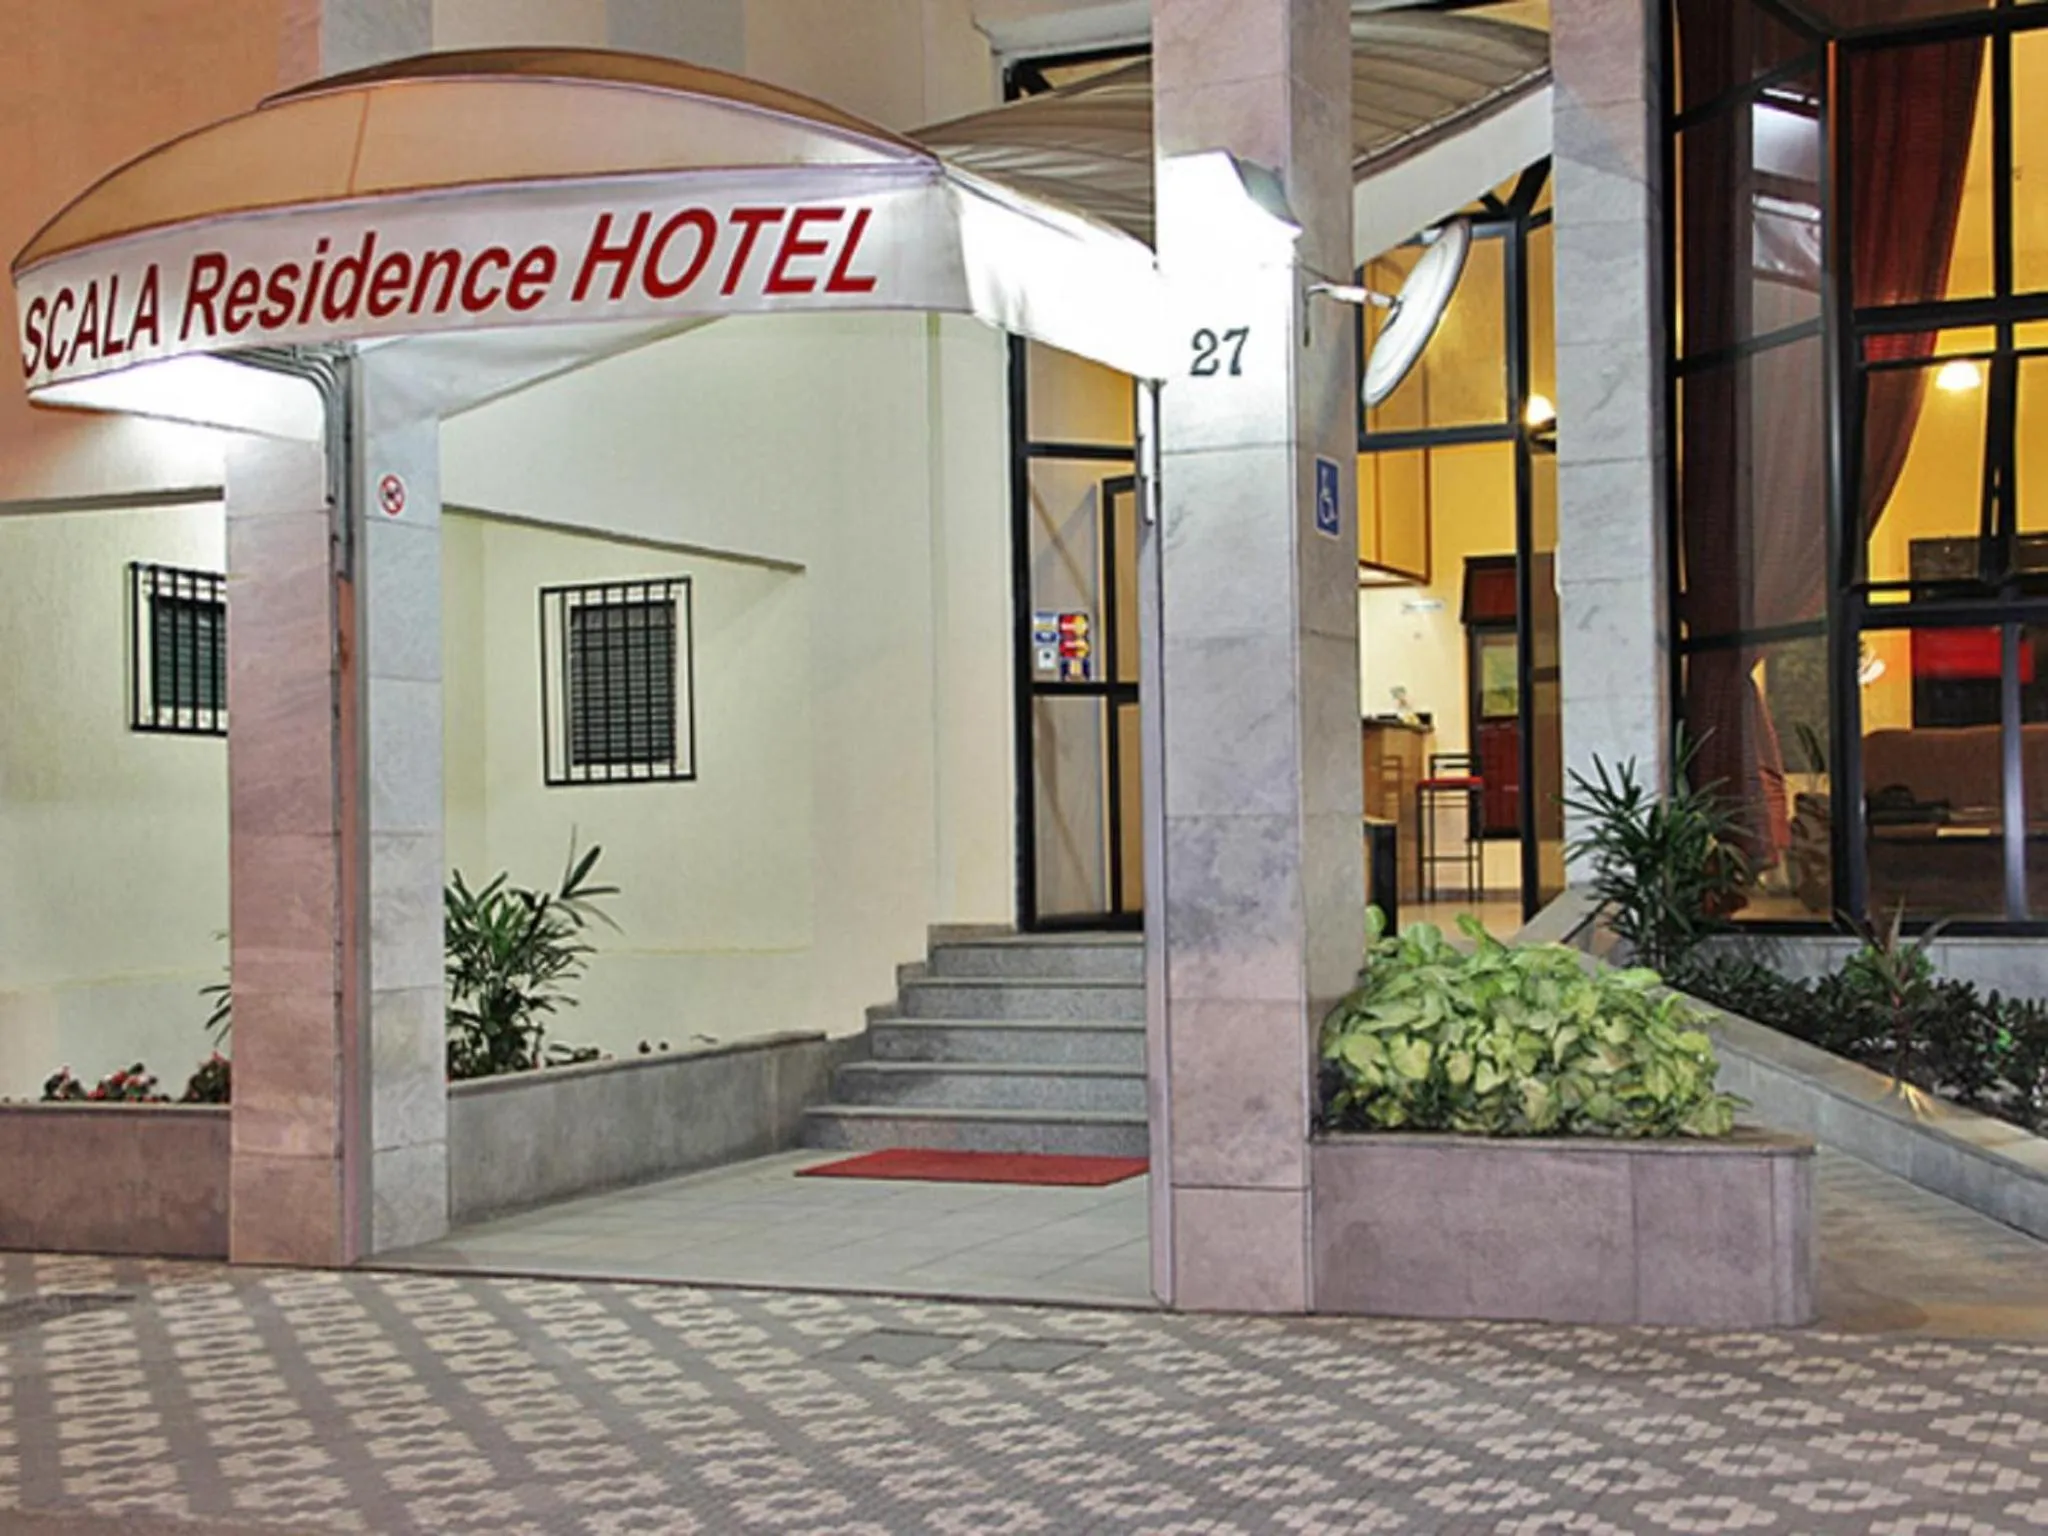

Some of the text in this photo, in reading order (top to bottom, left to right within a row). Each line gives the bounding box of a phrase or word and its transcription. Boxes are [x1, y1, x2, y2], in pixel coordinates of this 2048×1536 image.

[23, 207, 878, 377] SCALA Residence HOTEL
[1189, 326, 1250, 376] 27
